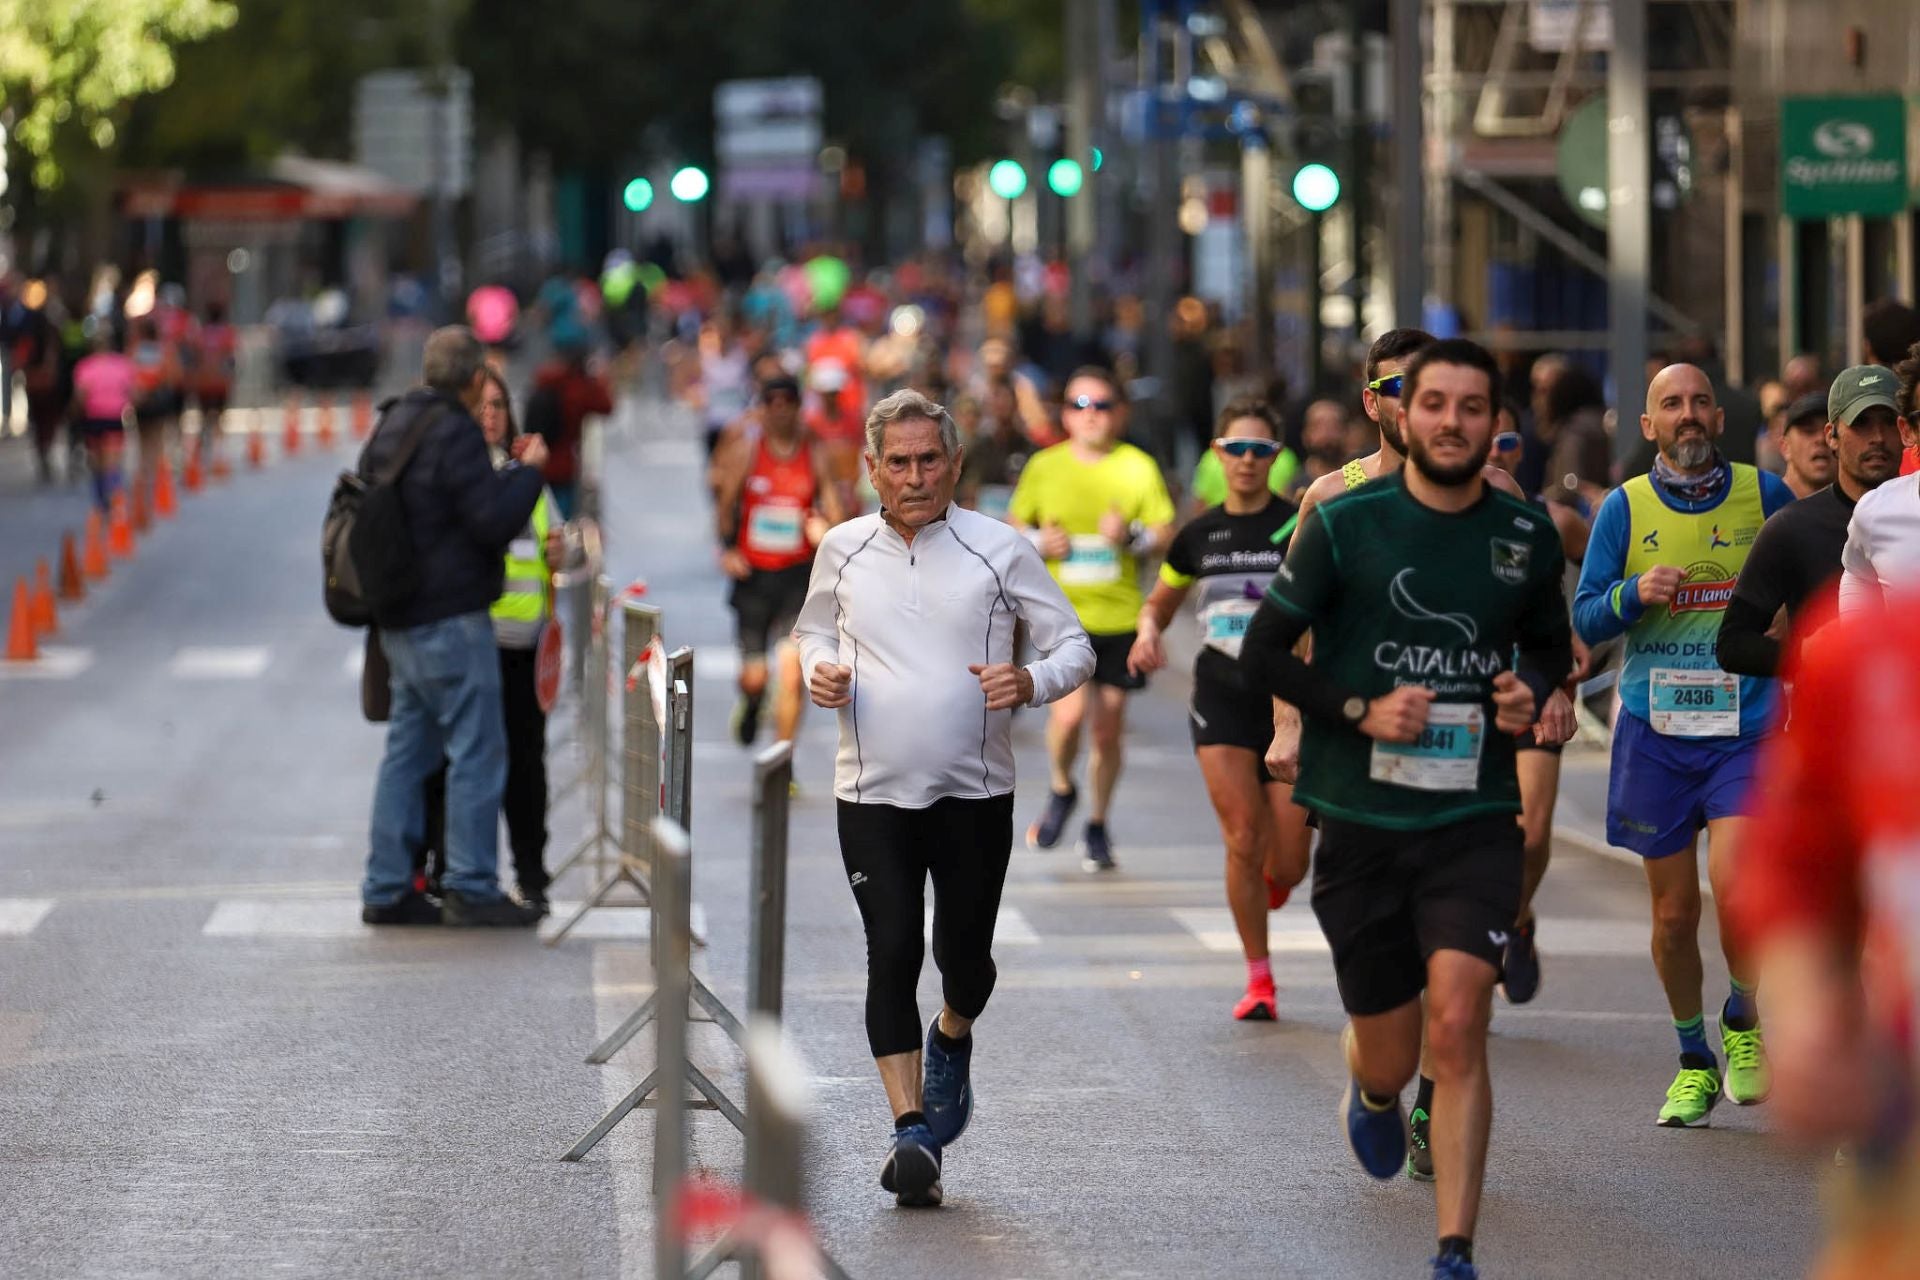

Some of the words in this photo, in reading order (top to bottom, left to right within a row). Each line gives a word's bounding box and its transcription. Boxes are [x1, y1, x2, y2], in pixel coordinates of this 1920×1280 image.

[1677, 591, 1689, 605] El
[1692, 588, 1733, 604] Llano
[1374, 641, 1501, 676] CATALINA
[1682, 643, 1706, 657] DE
[1674, 689, 1715, 706] 2436
[1411, 728, 1455, 750] 841
